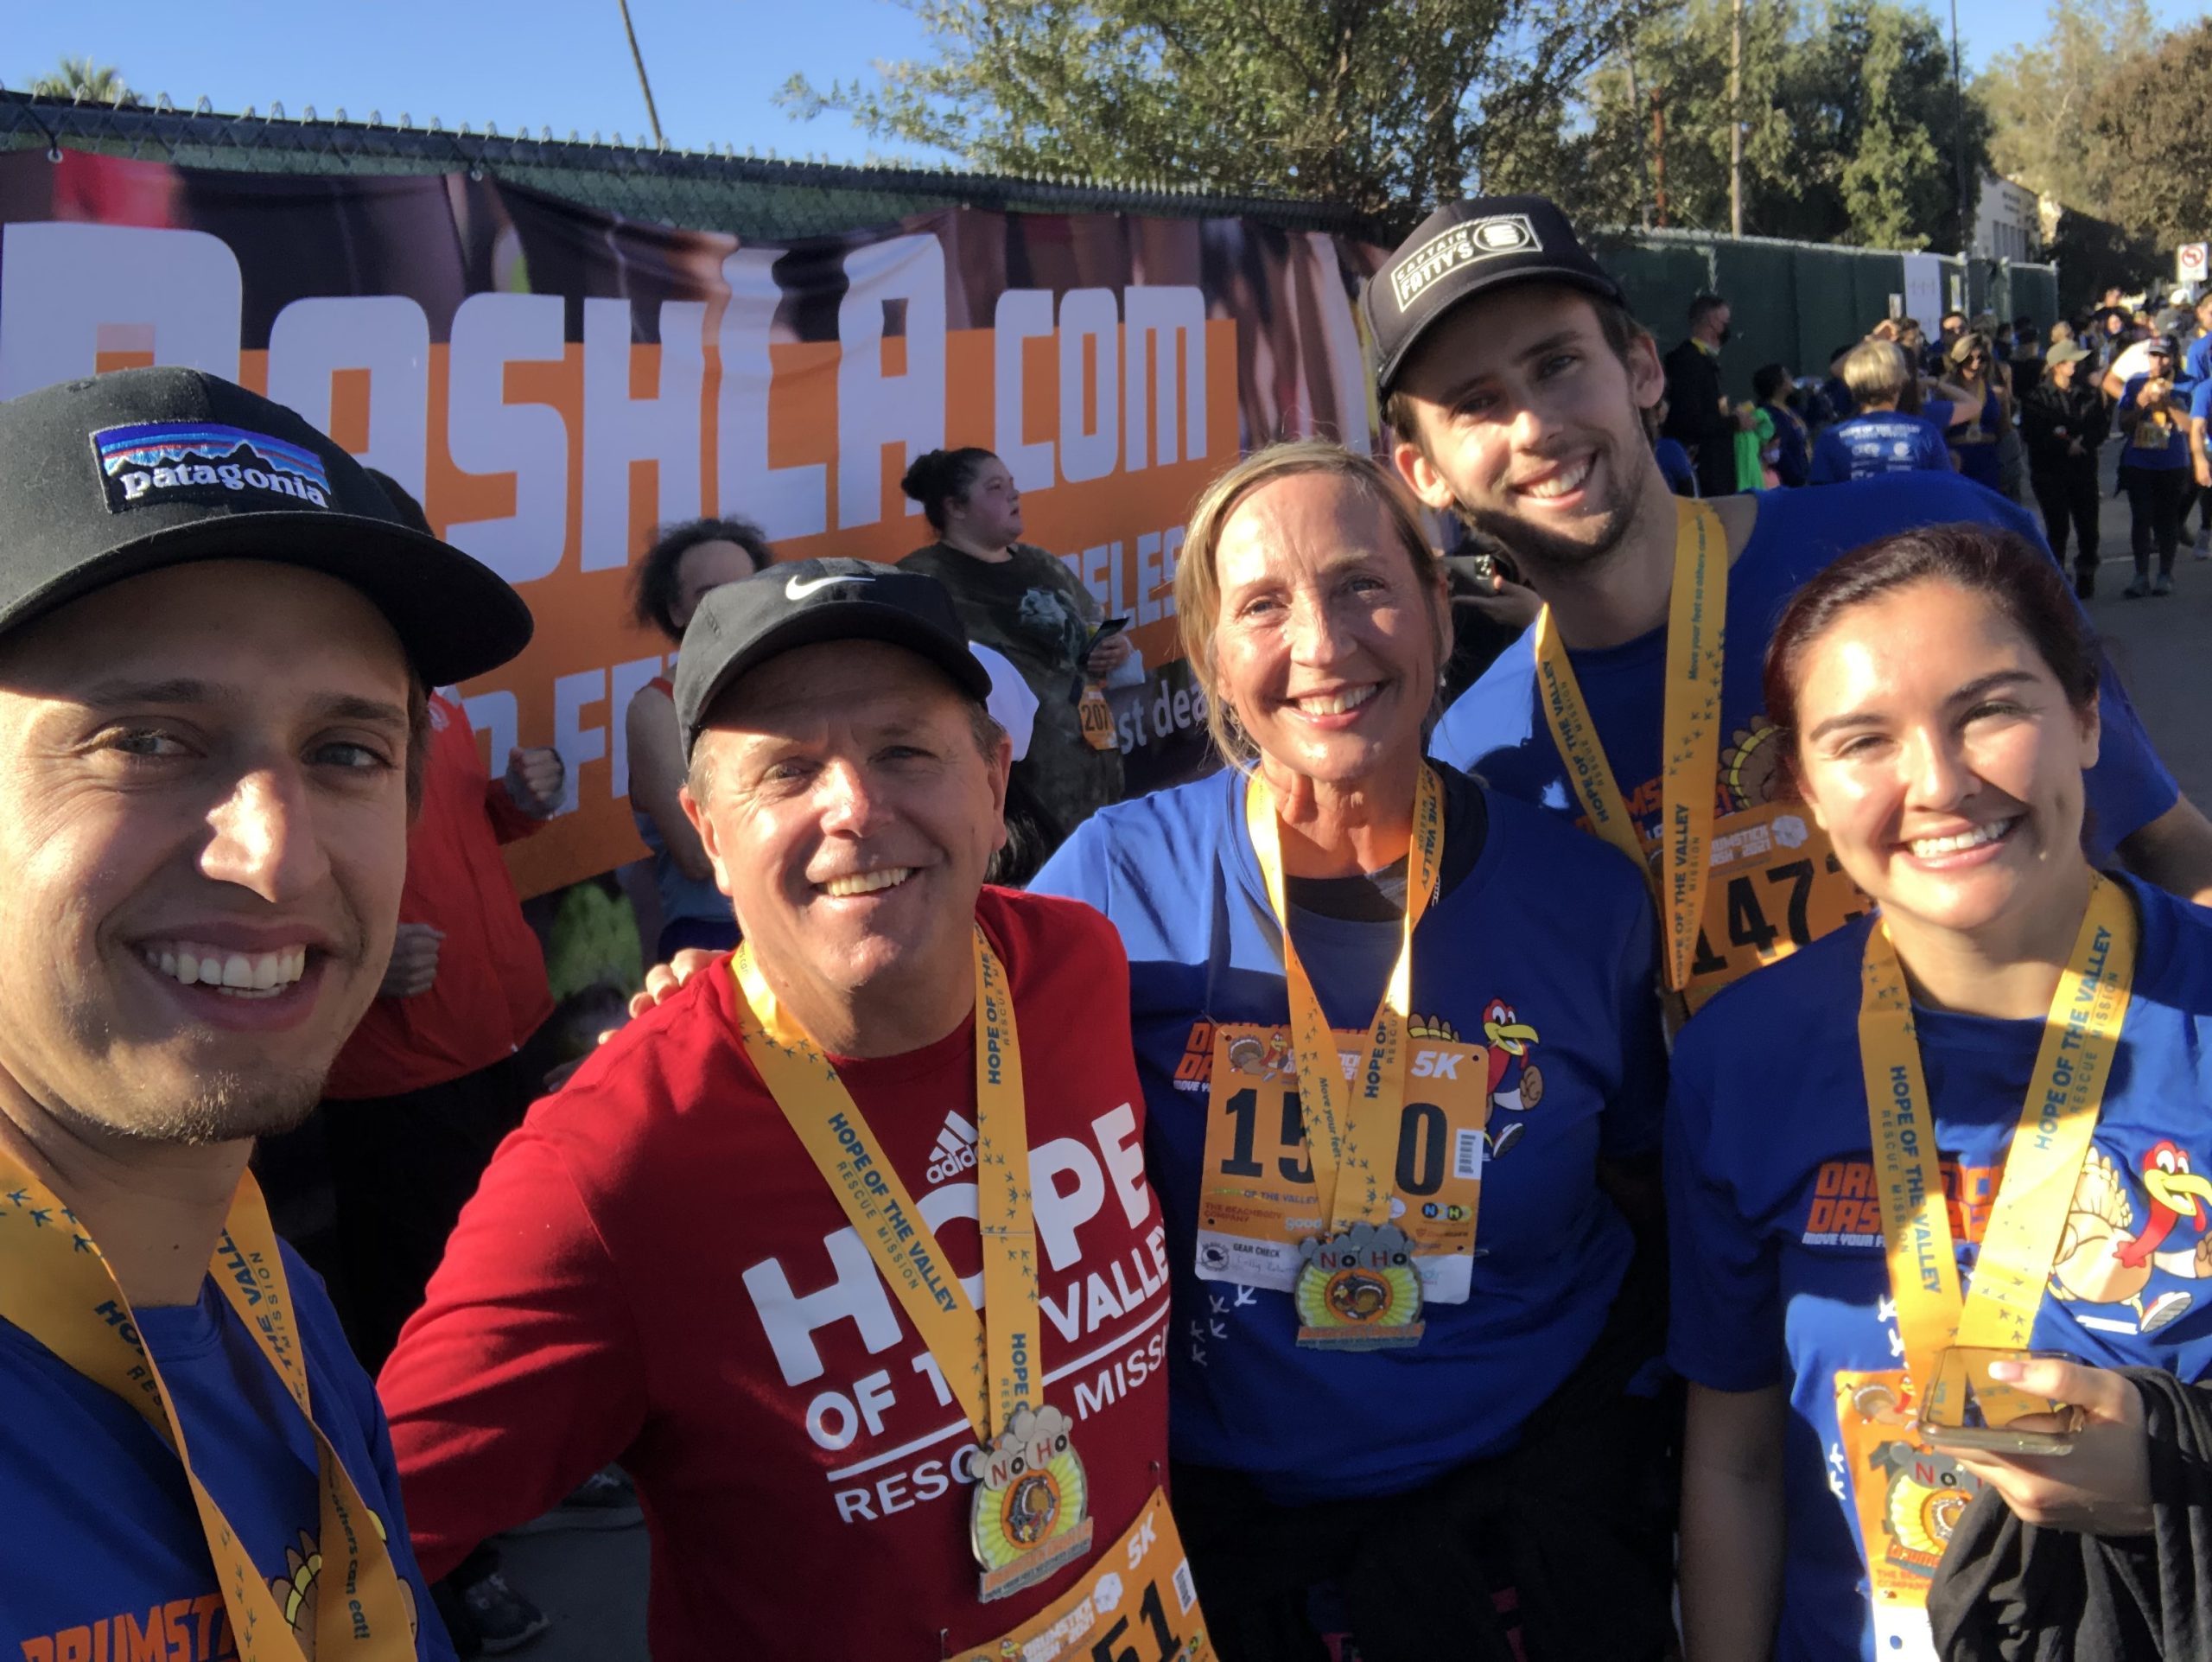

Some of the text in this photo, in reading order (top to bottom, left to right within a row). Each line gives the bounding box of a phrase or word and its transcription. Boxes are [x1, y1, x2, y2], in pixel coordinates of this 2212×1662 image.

[1396, 229, 1468, 281] CAPTAIN
[1400, 242, 1473, 300] FATTY'S
[120, 459, 328, 508] patagonia
[1061, 526, 1185, 629] ELES
[1118, 679, 1208, 755] st dea
[1542, 660, 1610, 823] HOPE OF THE VALLEY
[1427, 796, 1438, 825] THE
[1675, 804, 1688, 867] VALLEY
[1675, 872, 1687, 905] THE
[1689, 836, 1700, 891] MISSION
[1675, 912, 1684, 934] OF
[1692, 856, 1858, 974] 147
[981, 952, 994, 990] THE
[986, 996, 998, 1024] OF
[2033, 925, 2113, 1151] HOPE OF THE VALLEY
[988, 1026, 1002, 1086] HOPE
[1363, 1021, 1387, 1099] HOPE OF
[1410, 1050, 1465, 1079] 5K
[2069, 971, 2120, 1115] RESCUE MISSION
[1220, 1088, 1447, 1197] 150
[1319, 1077, 1342, 1159] Move your feet
[925, 1144, 979, 1185] adid
[1882, 1109, 1910, 1255] RESCUE MISSION
[1890, 1065, 1942, 1294] HOPE OF THE VALLEY
[827, 1111, 873, 1172] HOPE
[864, 1169, 891, 1198] OF
[883, 1198, 915, 1243] THE
[908, 1240, 959, 1314] VALLEY
[836, 1160, 920, 1290] RESCUE MISSION
[1261, 1192, 1280, 1202] THE
[1283, 1194, 1318, 1205] VALLEY
[1806, 1198, 1884, 1234] DAS
[1233, 1243, 1281, 1258] GEAR CHECK
[1840, 1233, 1873, 1246] YOUR
[217, 1227, 293, 1371] THE VALL
[250, 1251, 291, 1349] MISSION
[805, 1369, 897, 1451] OF
[1038, 1225, 1169, 1343] VALLE
[1011, 1333, 1030, 1397] HOPE
[833, 1324, 1167, 1525] RESC MISSI
[1001, 1377, 1011, 1424] RESC
[332, 1493, 371, 1640] others can eat!
[1127, 1512, 1156, 1570] 5K
[21, 1593, 239, 1662] RUMST
